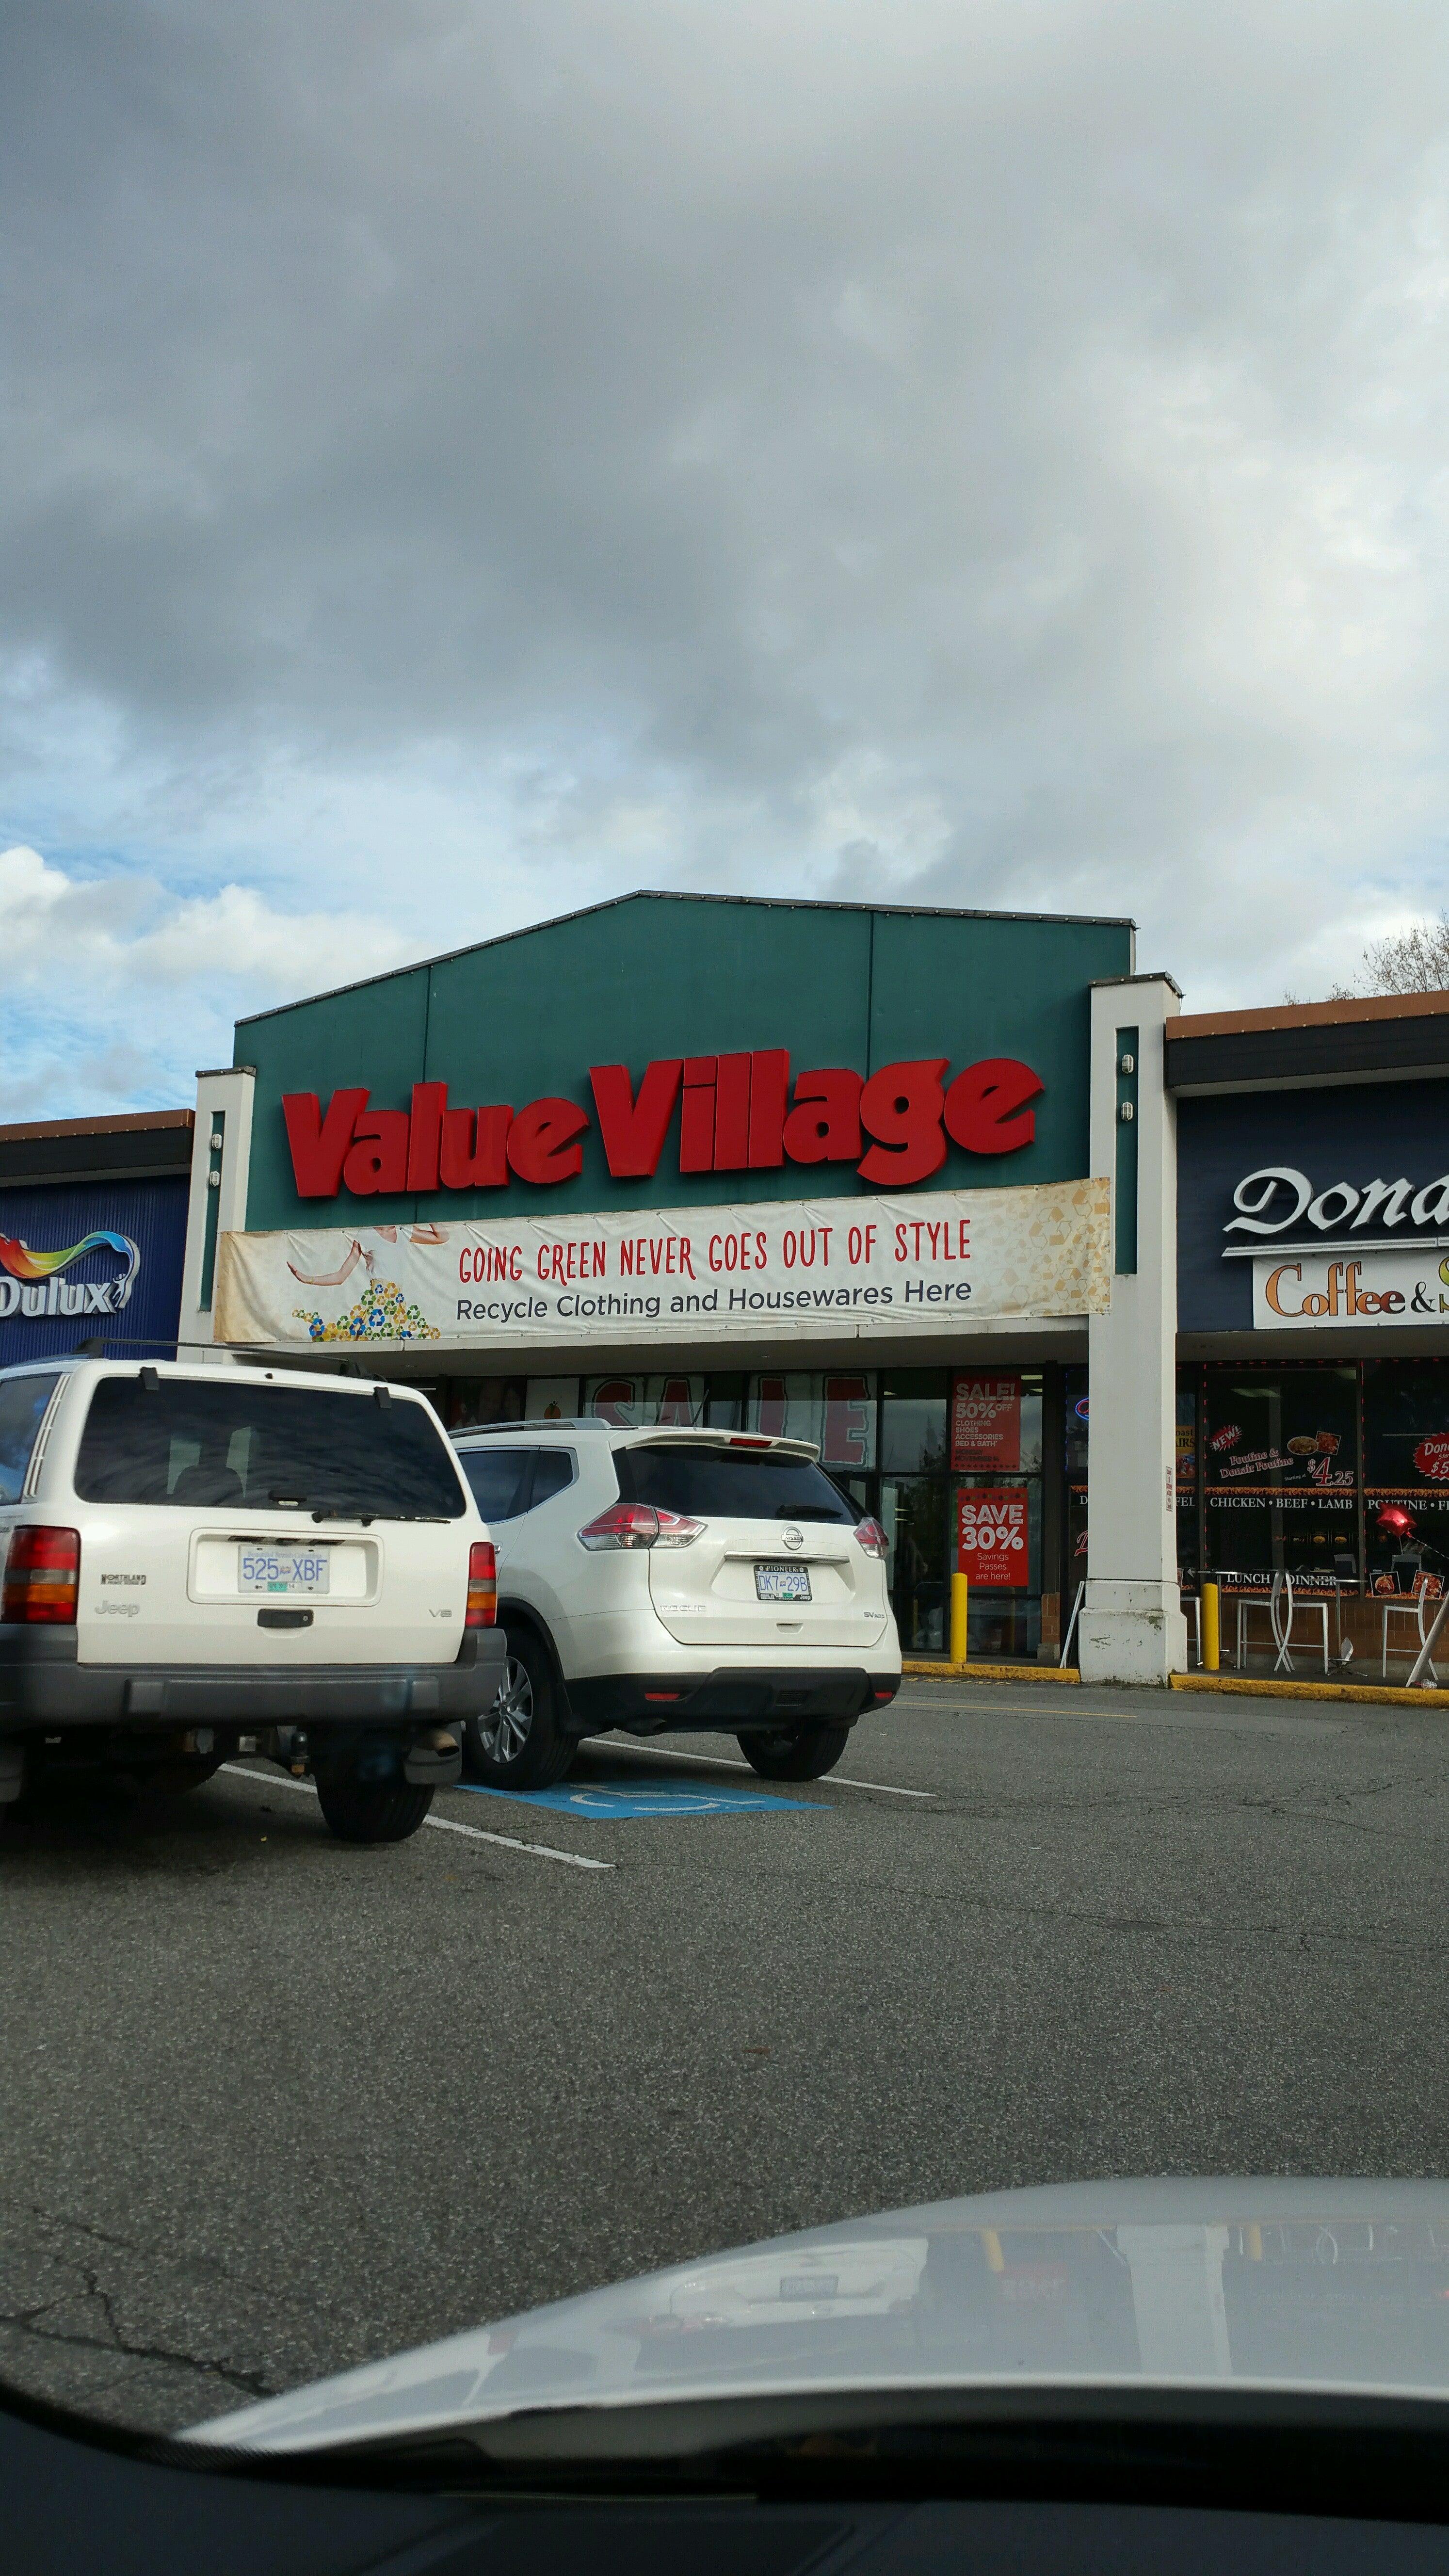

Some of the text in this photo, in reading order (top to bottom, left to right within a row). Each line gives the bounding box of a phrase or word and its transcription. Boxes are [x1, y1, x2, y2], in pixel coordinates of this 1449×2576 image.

[282, 1048, 1045, 1197] Value Village
[459, 1219, 971, 1286] GOING GREEN NEVER GOES OUT OF STYLE
[0, 1276, 115, 1317] Dulux
[1265, 1261, 1406, 1317] Coffee
[457, 1280, 971, 1323] Recycle Clothing and Housewares Here
[956, 1383, 1015, 1401] SALE!
[956, 1402, 996, 1418] 50%
[1212, 1425, 1241, 1451] NEW!
[1229, 1448, 1280, 1466] Poutine &
[1424, 1442, 1449, 1456] Don
[1219, 1457, 1294, 1479] Donair Poutine
[1210, 1497, 1353, 1509] CHICKEN BEEF LAMB
[962, 1505, 1024, 1525] SAVE
[962, 1526, 1024, 1550] 30%
[977, 1553, 1009, 1562] Savings
[243, 1558, 327, 1581] 525 XBF
[1226, 1574, 1271, 1584] LUNCH
[95, 1600, 141, 1618] Jeep
